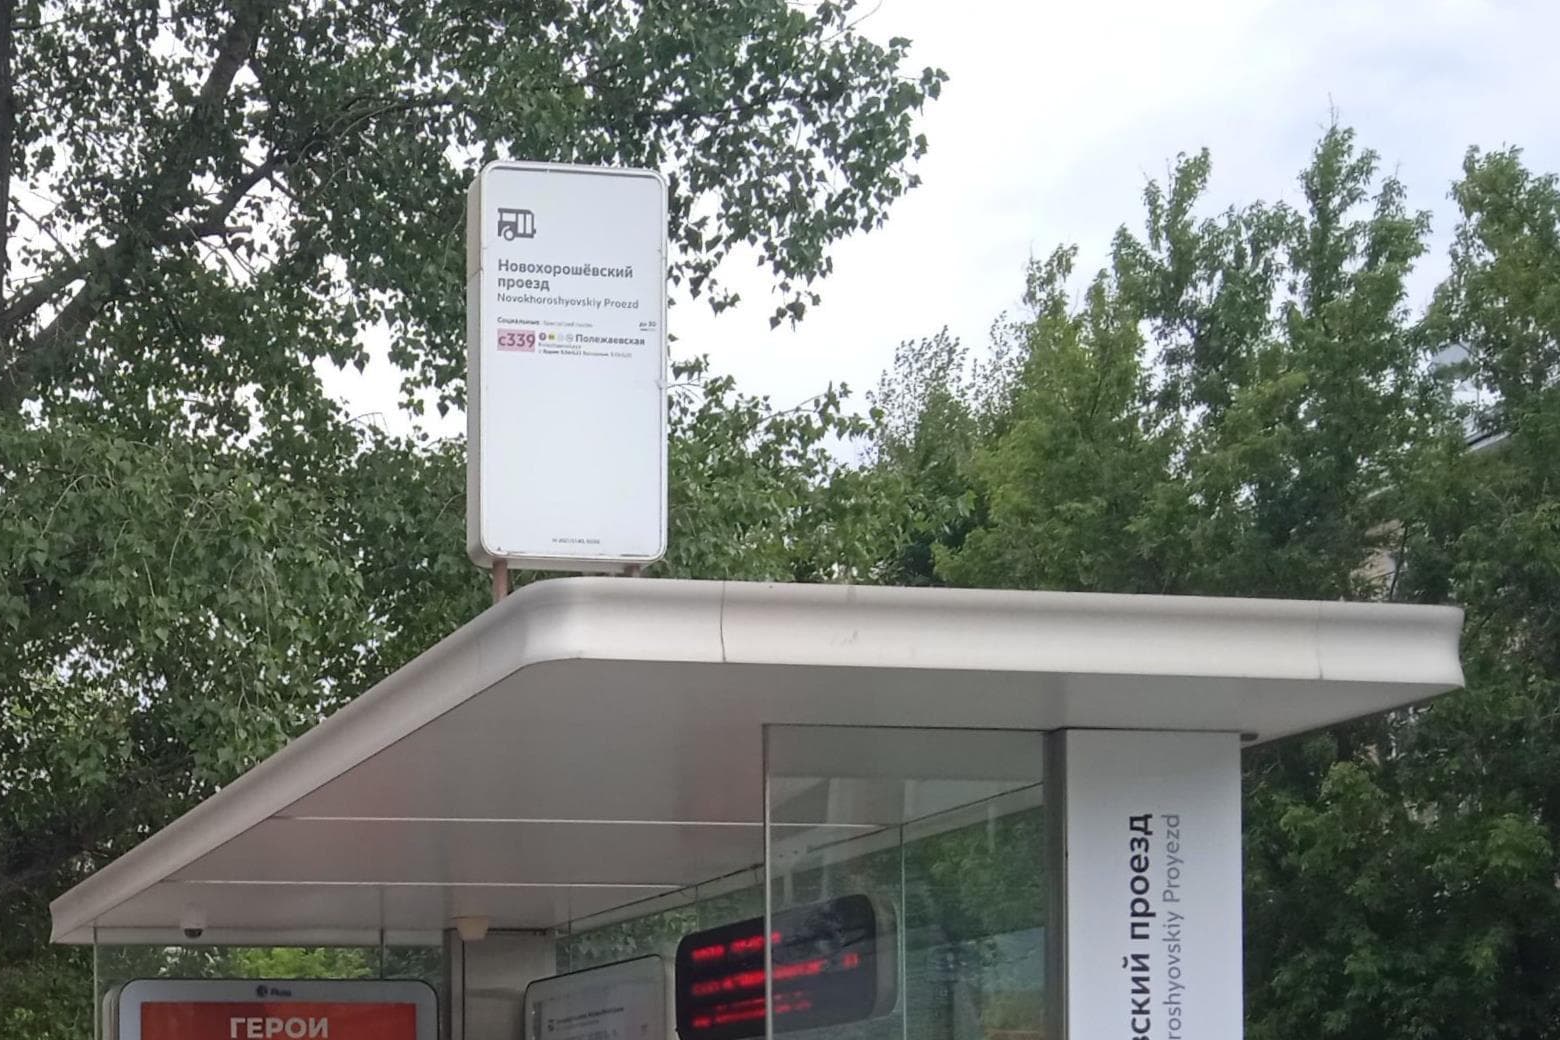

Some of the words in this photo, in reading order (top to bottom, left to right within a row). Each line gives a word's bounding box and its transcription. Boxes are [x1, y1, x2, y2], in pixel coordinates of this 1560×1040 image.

[497, 259, 633, 278] Новохорошёвский
[497, 277, 550, 291] проезд
[497, 293, 601, 309] Novokhoroshyovskiy
[603, 298, 640, 309] Proezd
[1161, 813, 1184, 903] Proyezd
[1129, 813, 1157, 940] проезд
[230, 1017, 329, 1039] ГЕРОИ
